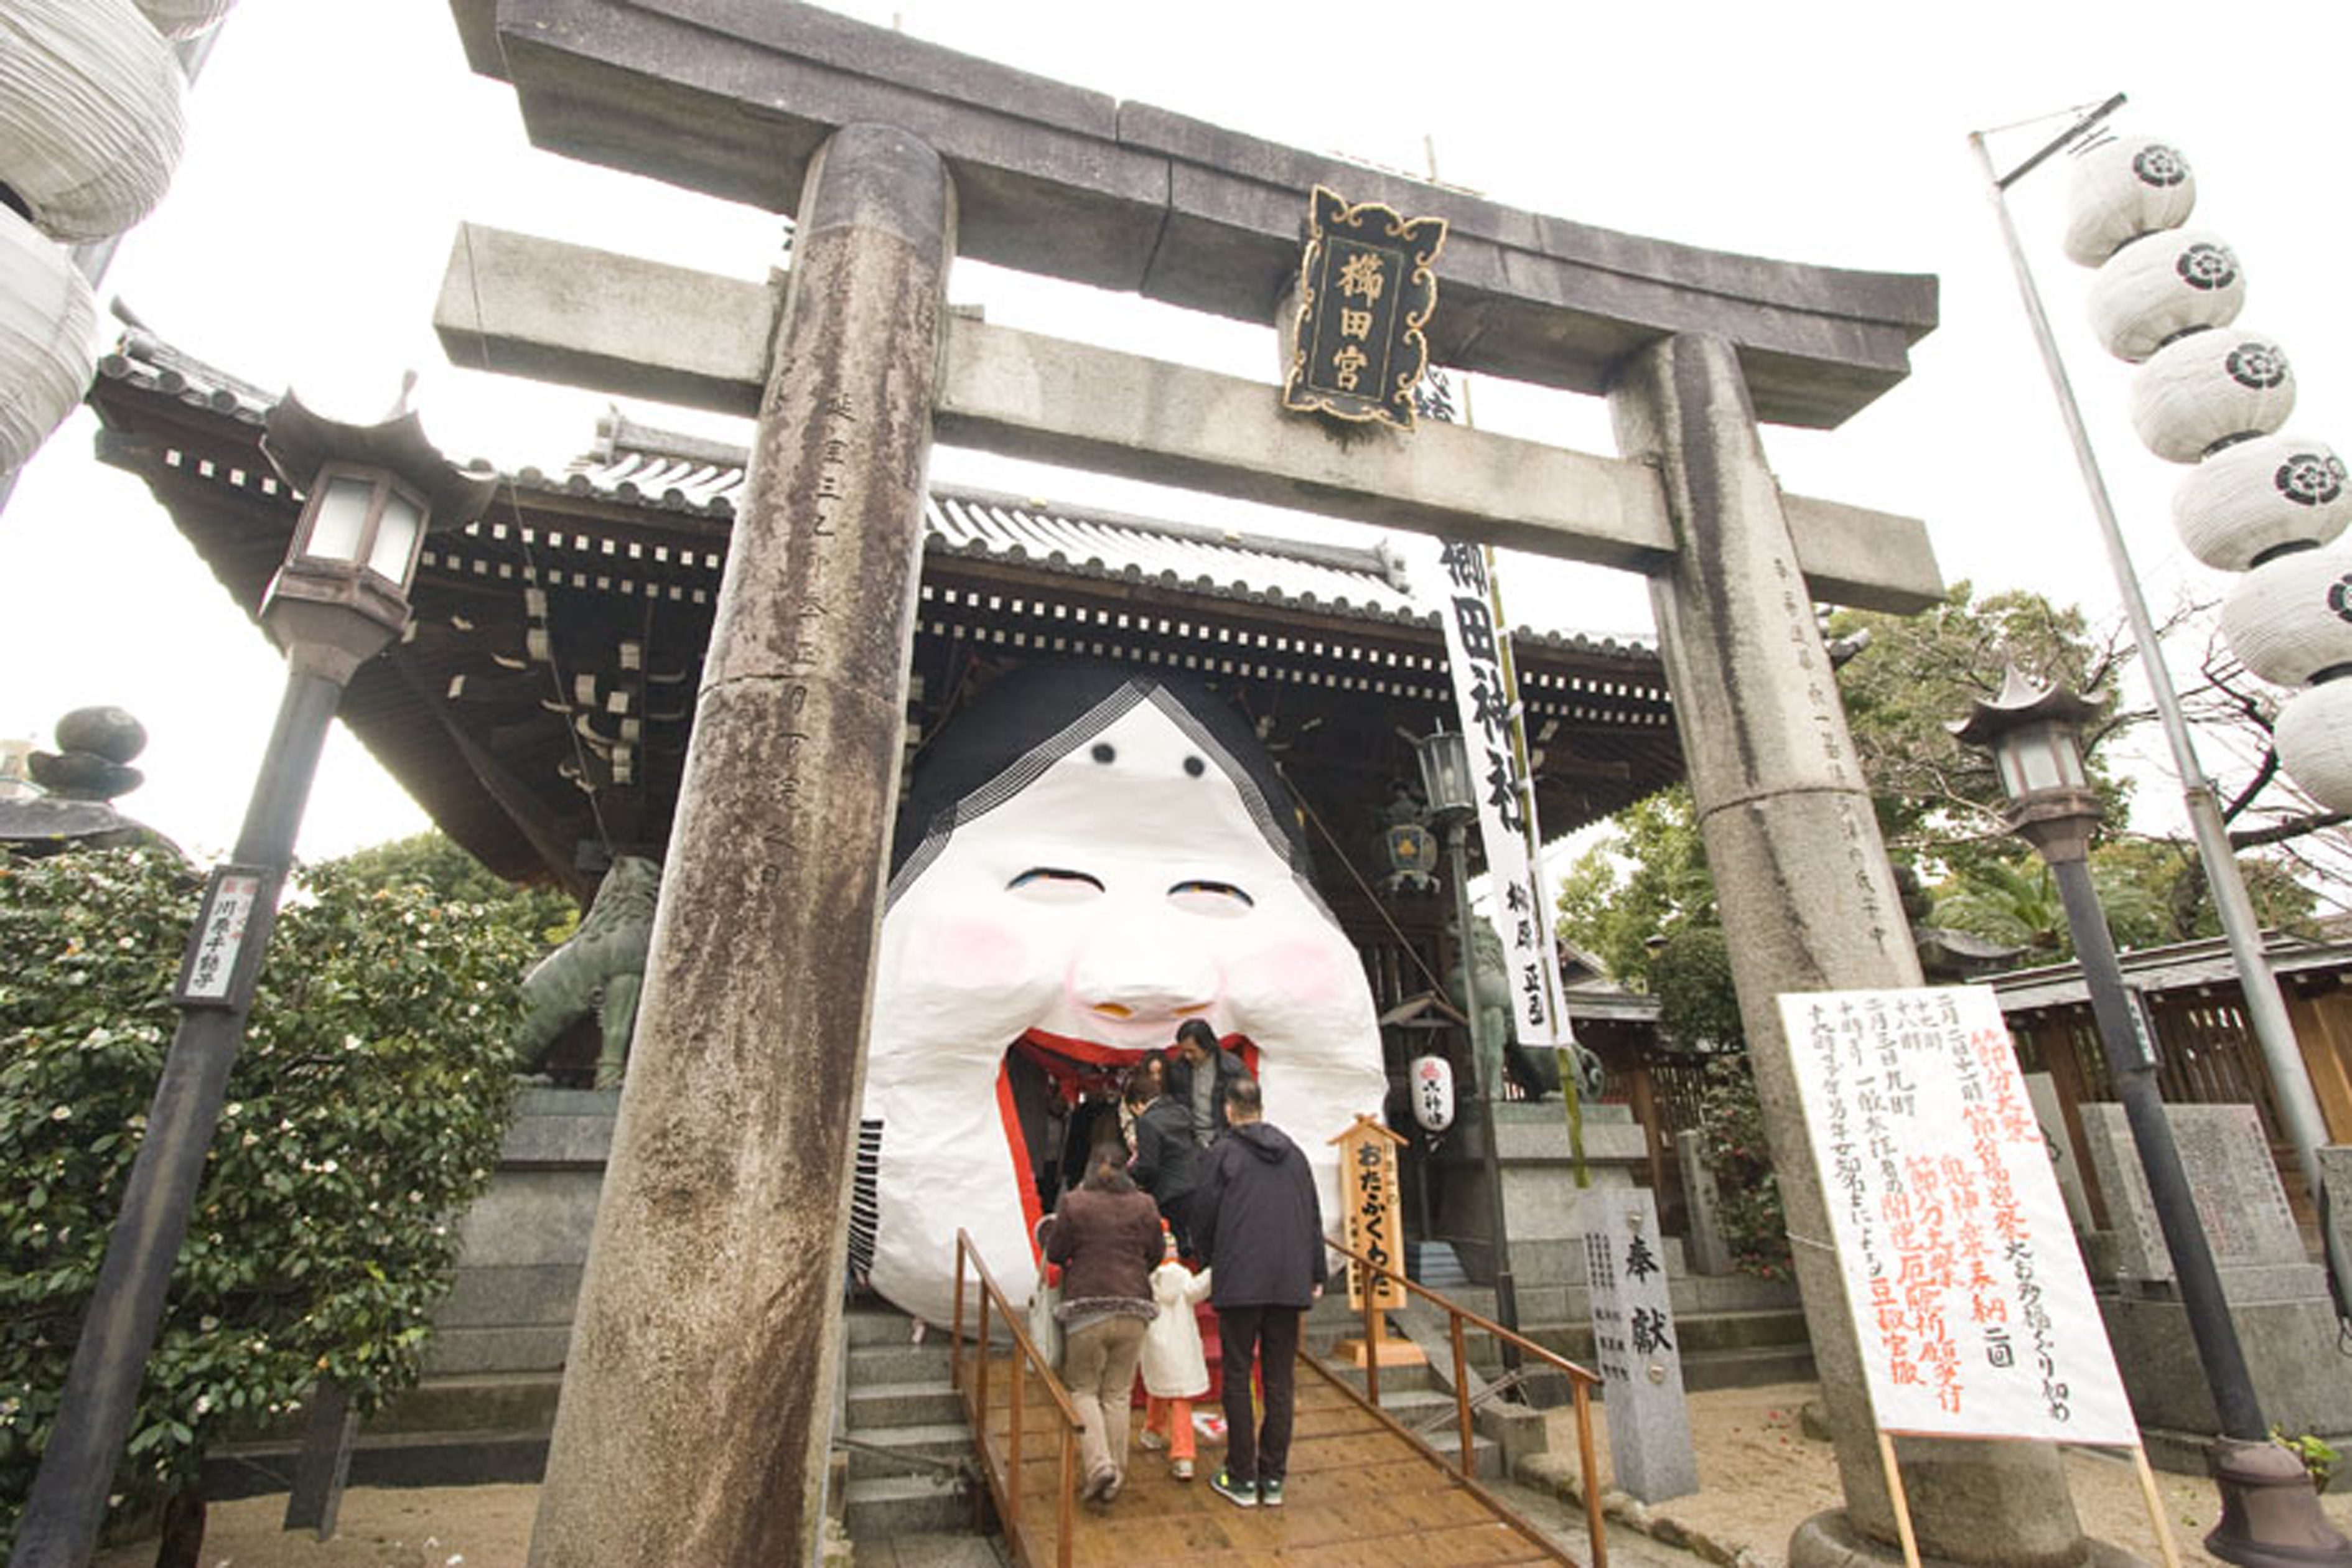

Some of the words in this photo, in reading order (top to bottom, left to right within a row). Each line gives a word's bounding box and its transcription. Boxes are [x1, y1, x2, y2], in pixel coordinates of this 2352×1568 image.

[1970, 1029, 2040, 1143] 節分大祭
[1984, 1326, 2015, 1368] 二回
